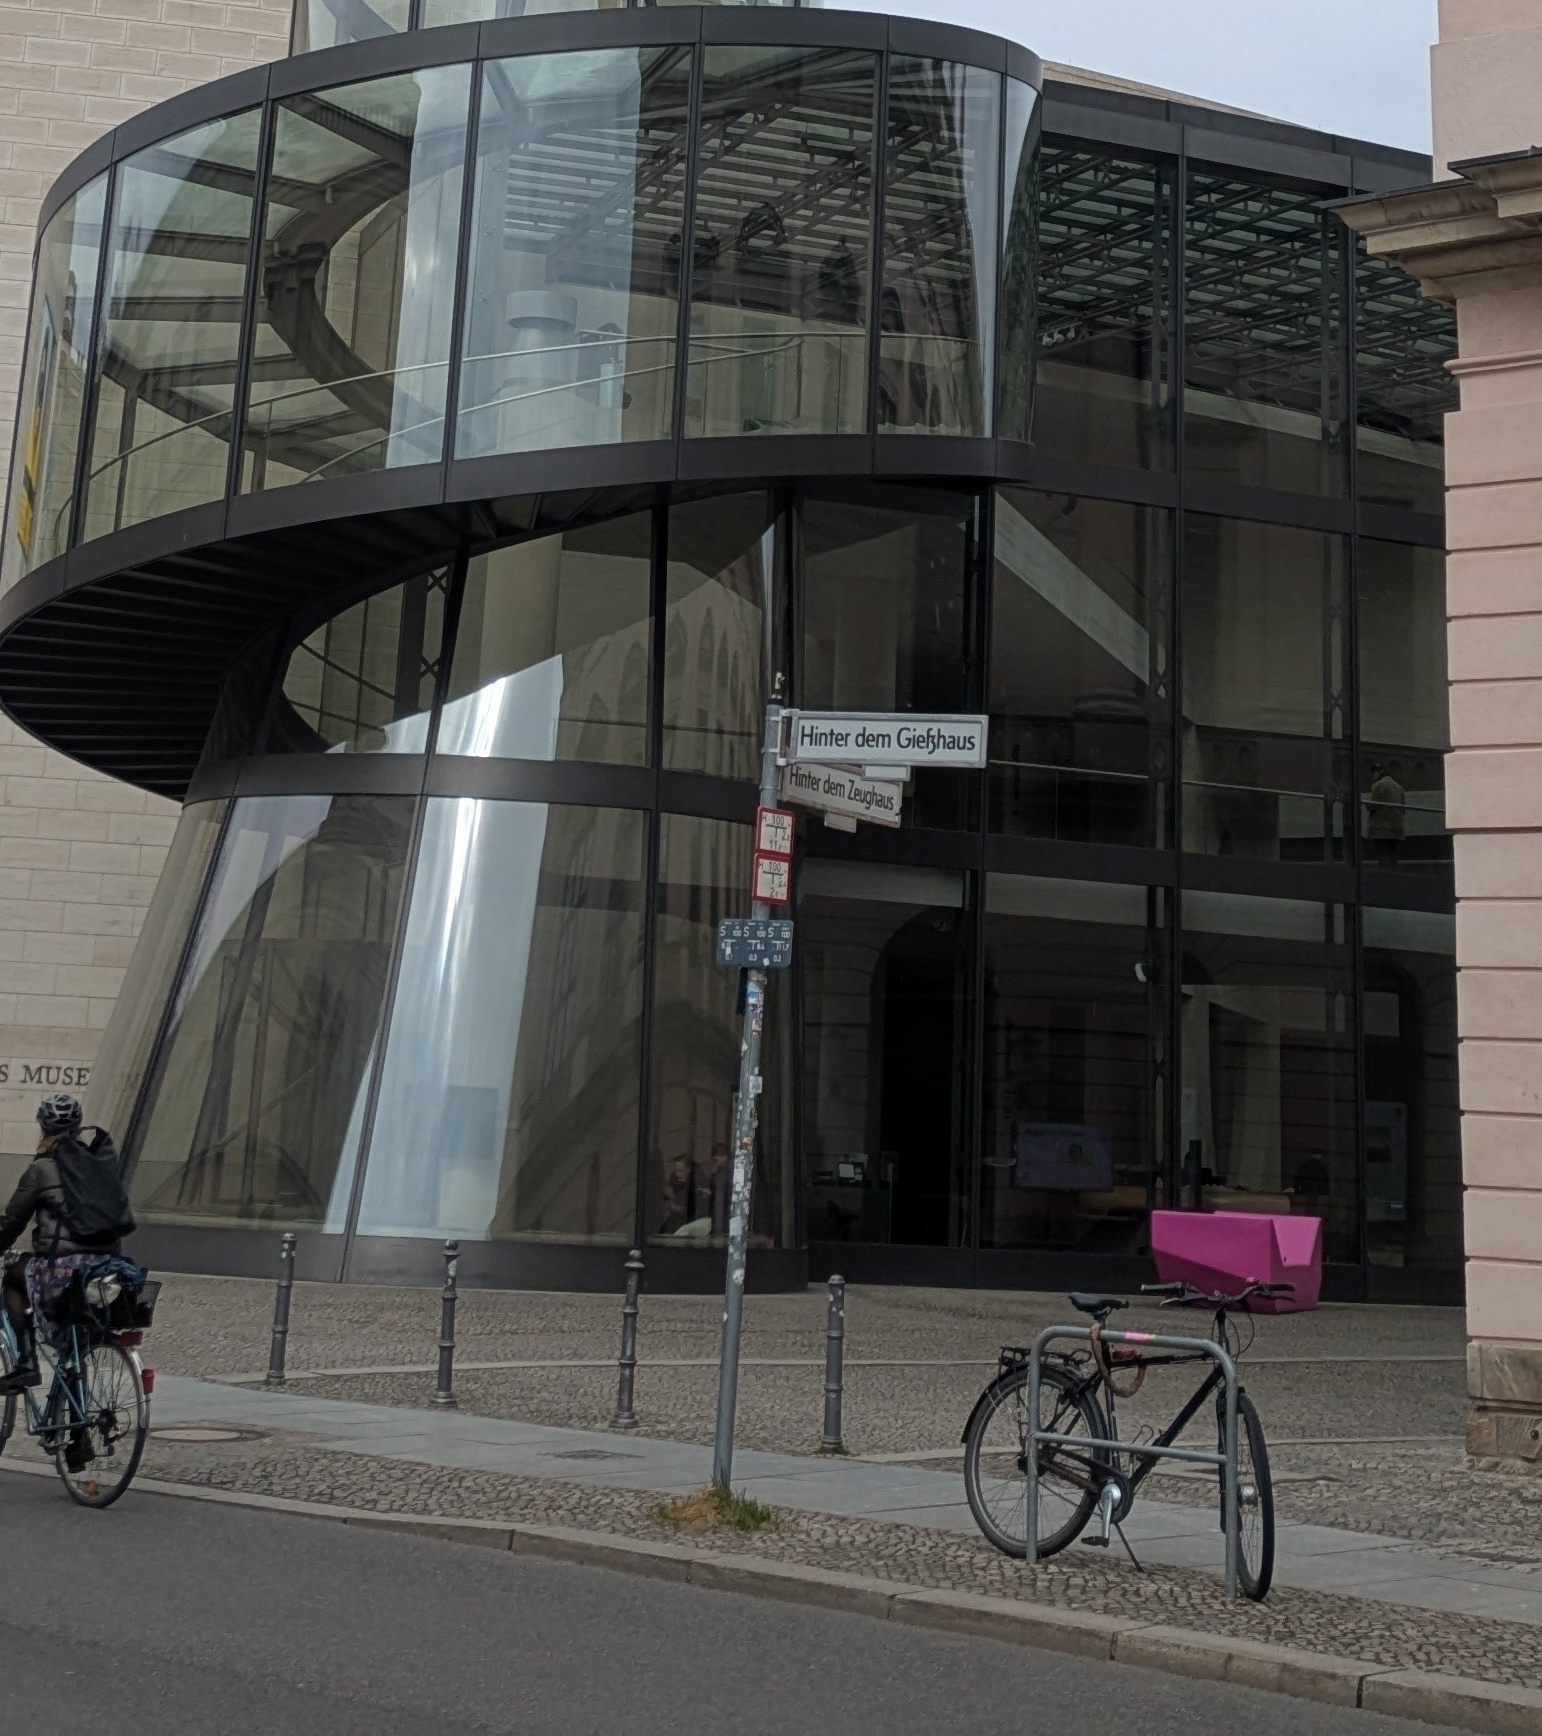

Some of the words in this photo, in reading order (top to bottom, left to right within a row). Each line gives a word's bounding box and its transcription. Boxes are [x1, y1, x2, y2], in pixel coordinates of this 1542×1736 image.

[800, 725, 852, 748] Hinter
[855, 726, 892, 749] dem
[896, 726, 976, 755] Gießhaus
[789, 765, 821, 791] Hinter
[823, 773, 846, 799] dem
[847, 778, 895, 811] Zeughaus
